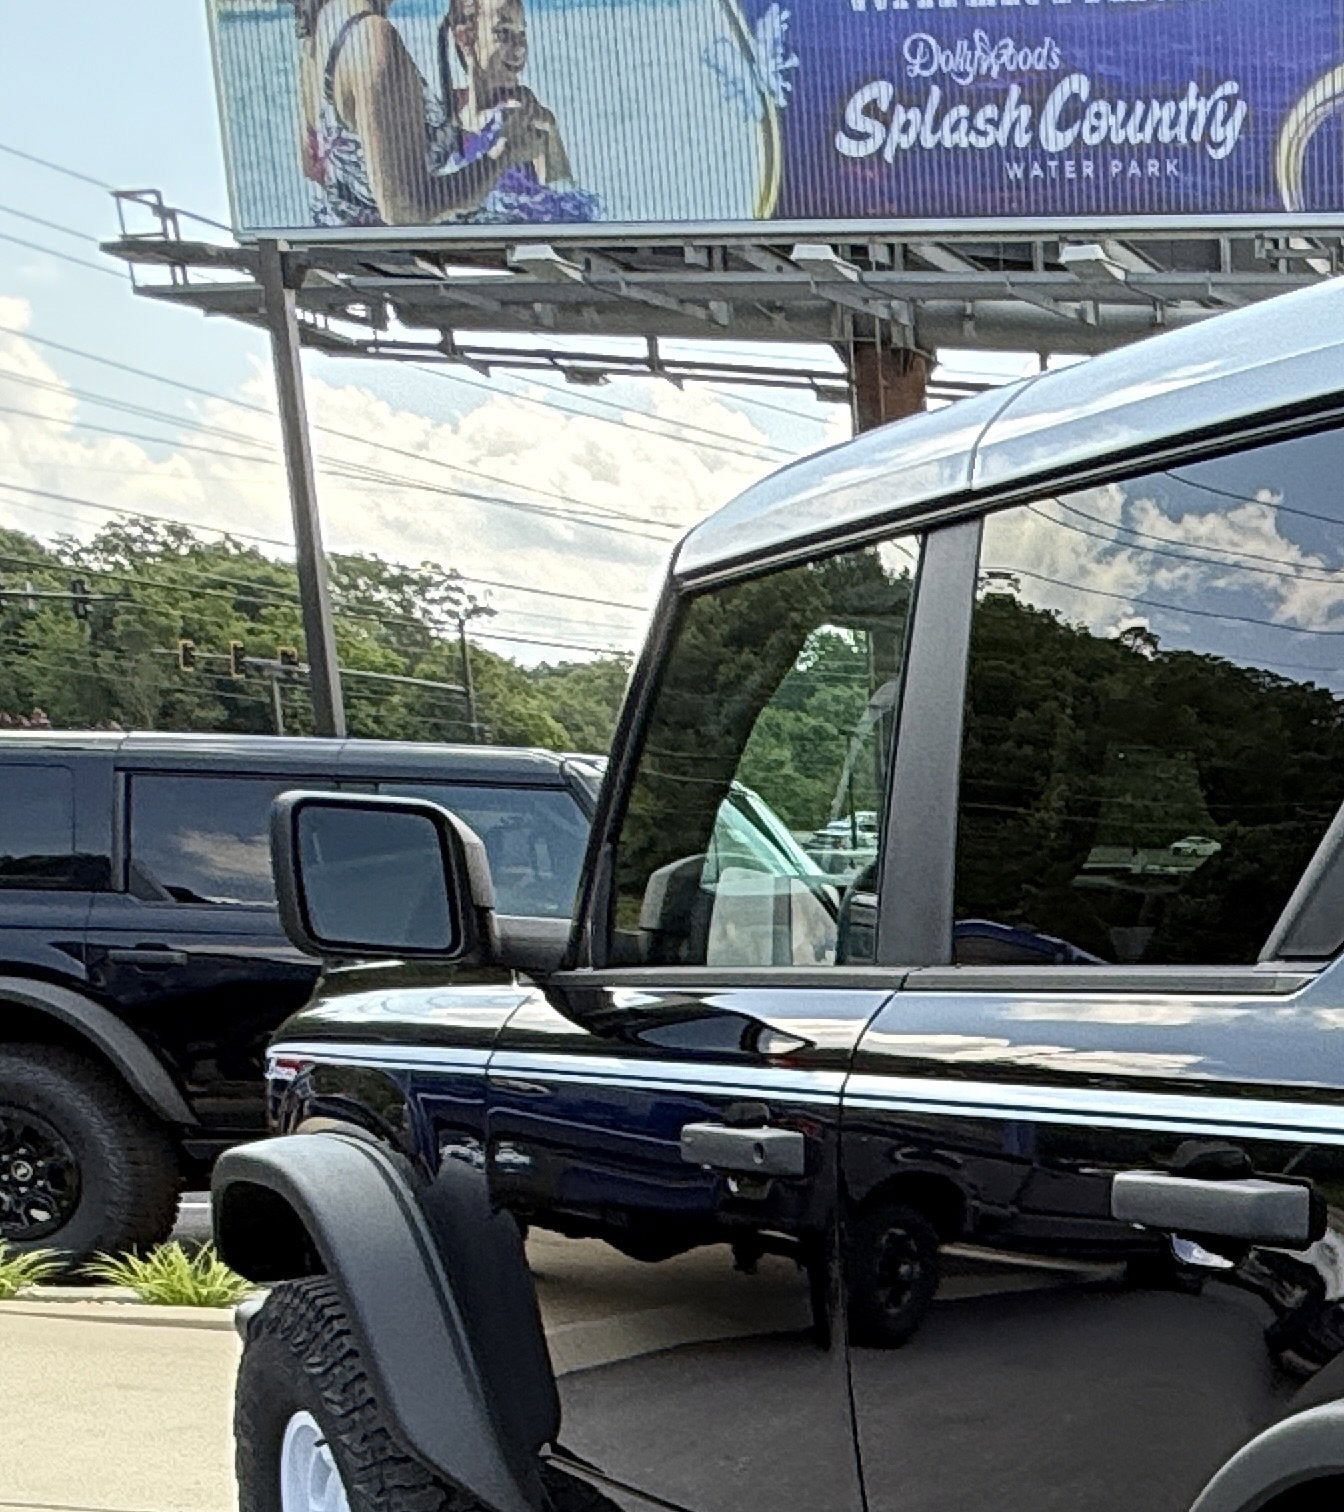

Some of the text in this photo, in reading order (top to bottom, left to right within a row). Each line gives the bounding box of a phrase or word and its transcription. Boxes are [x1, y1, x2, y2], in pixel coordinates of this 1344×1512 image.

[834, 72, 1247, 164] Splash Country
[1005, 157, 1181, 180] WATER PARK
